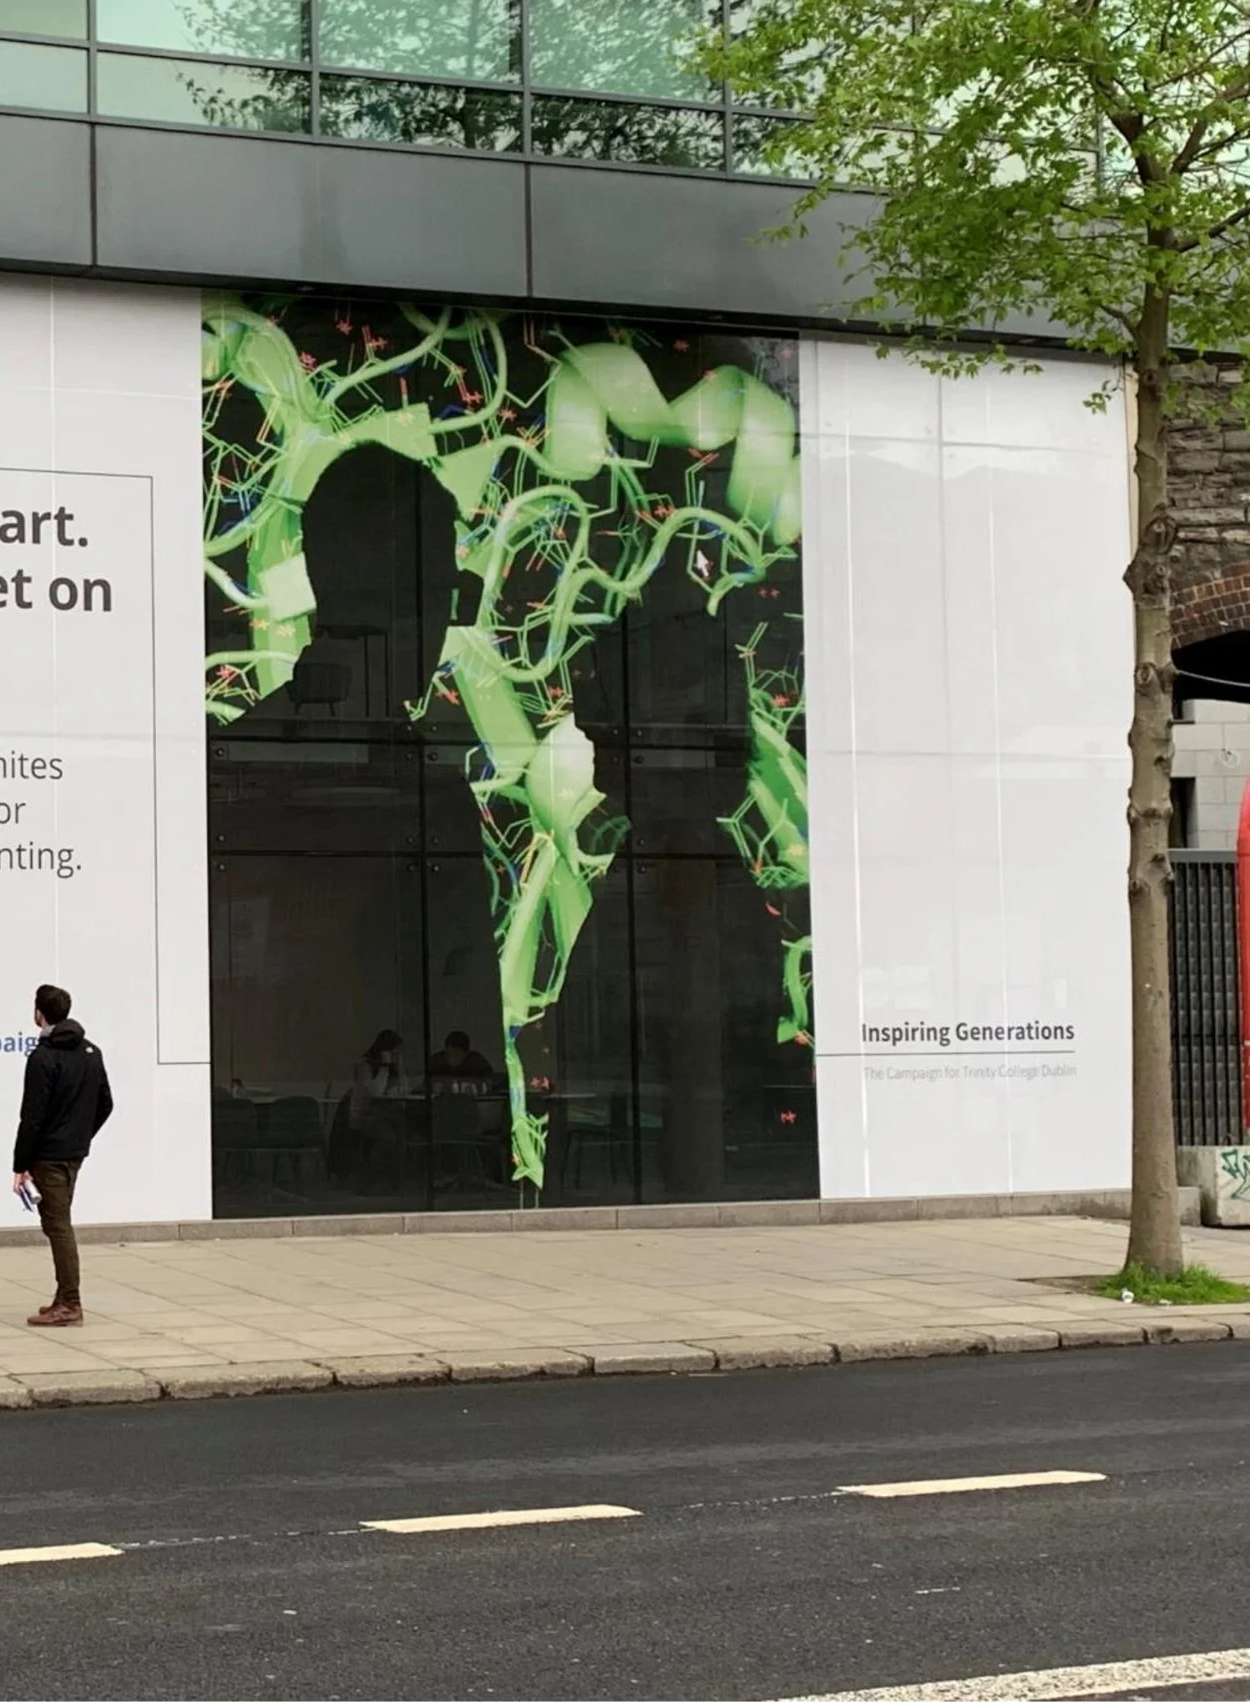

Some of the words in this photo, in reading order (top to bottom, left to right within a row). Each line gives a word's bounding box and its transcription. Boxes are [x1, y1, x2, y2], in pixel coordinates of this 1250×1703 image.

[49, 577, 112, 612] on
[862, 1021, 951, 1047] Inspiring
[955, 1020, 1075, 1041] Generations
[864, 1066, 885, 1080] The
[886, 1067, 941, 1082] Campaign
[945, 1066, 960, 1079] for
[963, 1065, 996, 1080] Trinity
[998, 1064, 1038, 1081] College
[1041, 1064, 1076, 1077] Dublin
